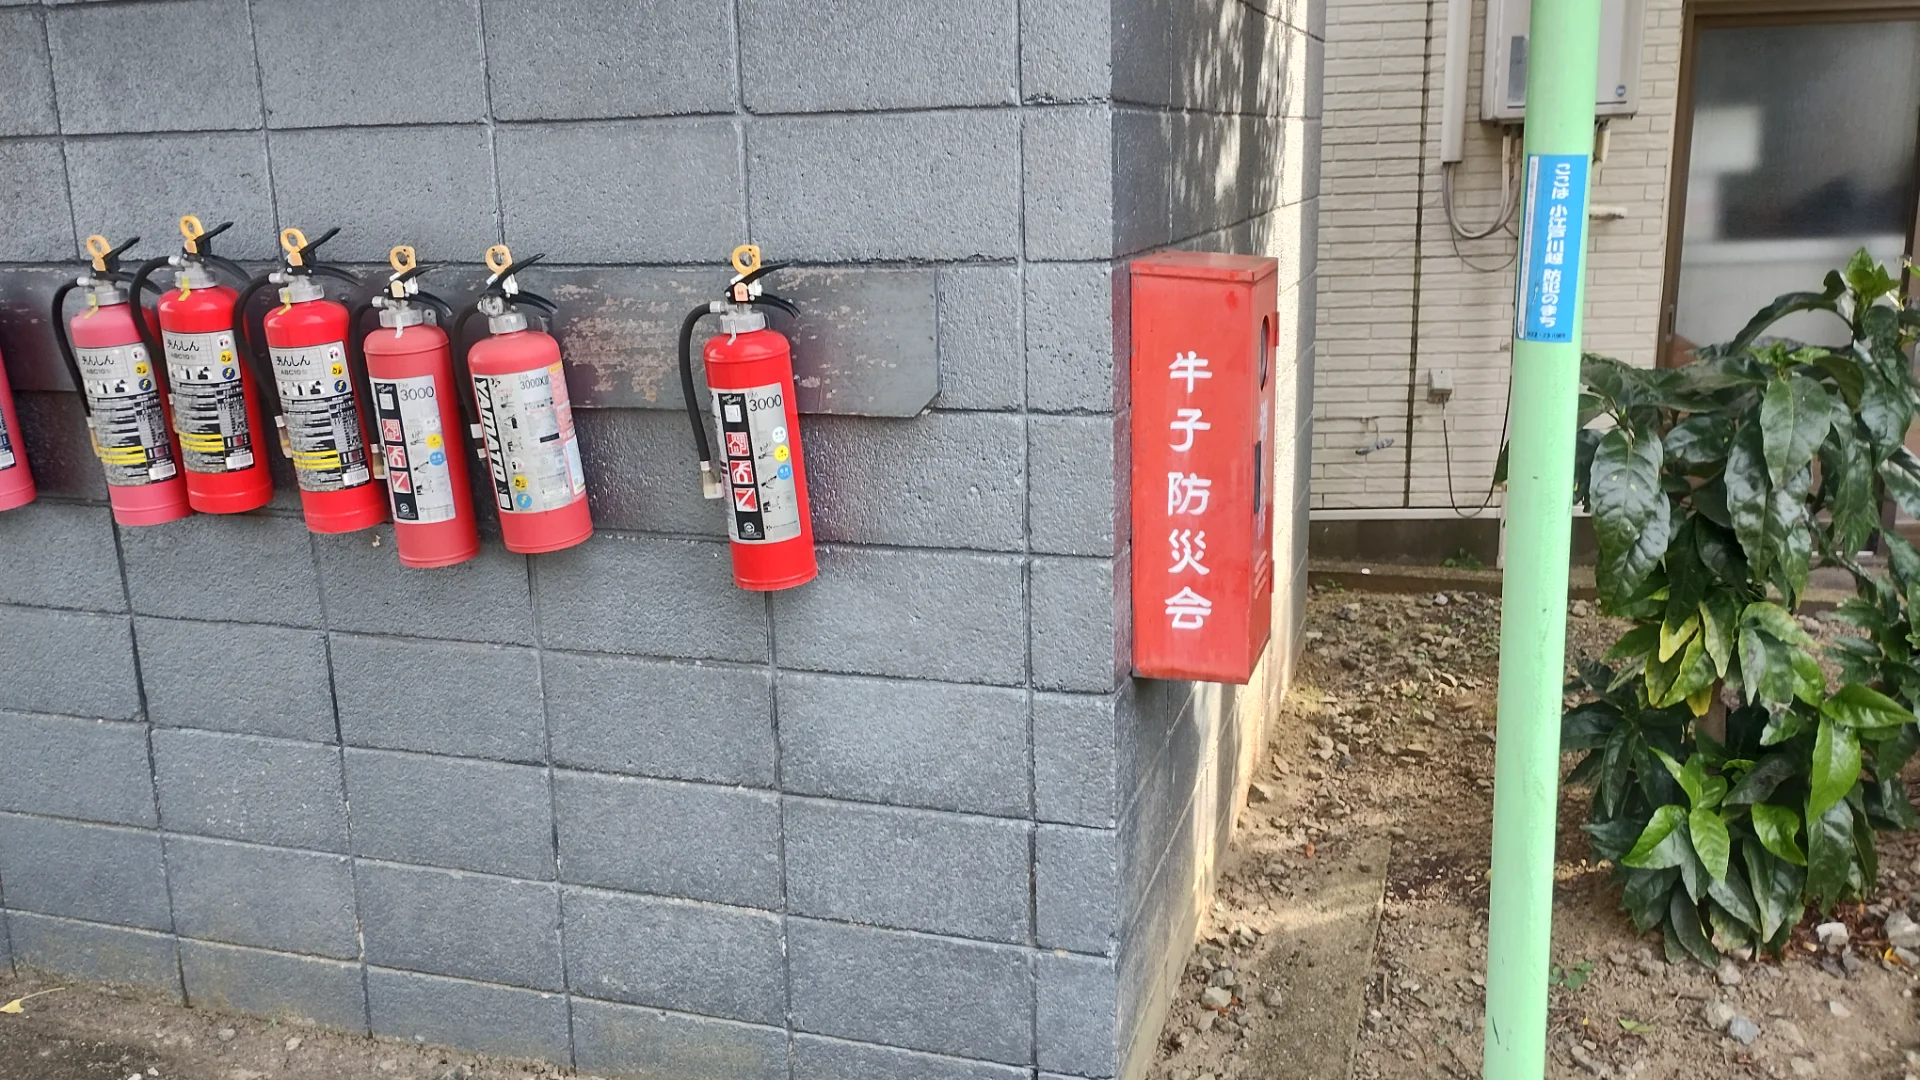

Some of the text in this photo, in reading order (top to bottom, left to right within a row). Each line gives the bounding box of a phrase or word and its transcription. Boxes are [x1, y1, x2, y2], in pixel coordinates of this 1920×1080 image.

[1551, 162, 1571, 200] ここは
[1545, 203, 1568, 265] 小江戸川越
[1539, 268, 1563, 328] 防犯のまち
[399, 386, 435, 401] 3000
[749, 394, 783, 412] 3000
[475, 379, 507, 484] YAMATO
[1164, 350, 1213, 629] 牛子防災会
